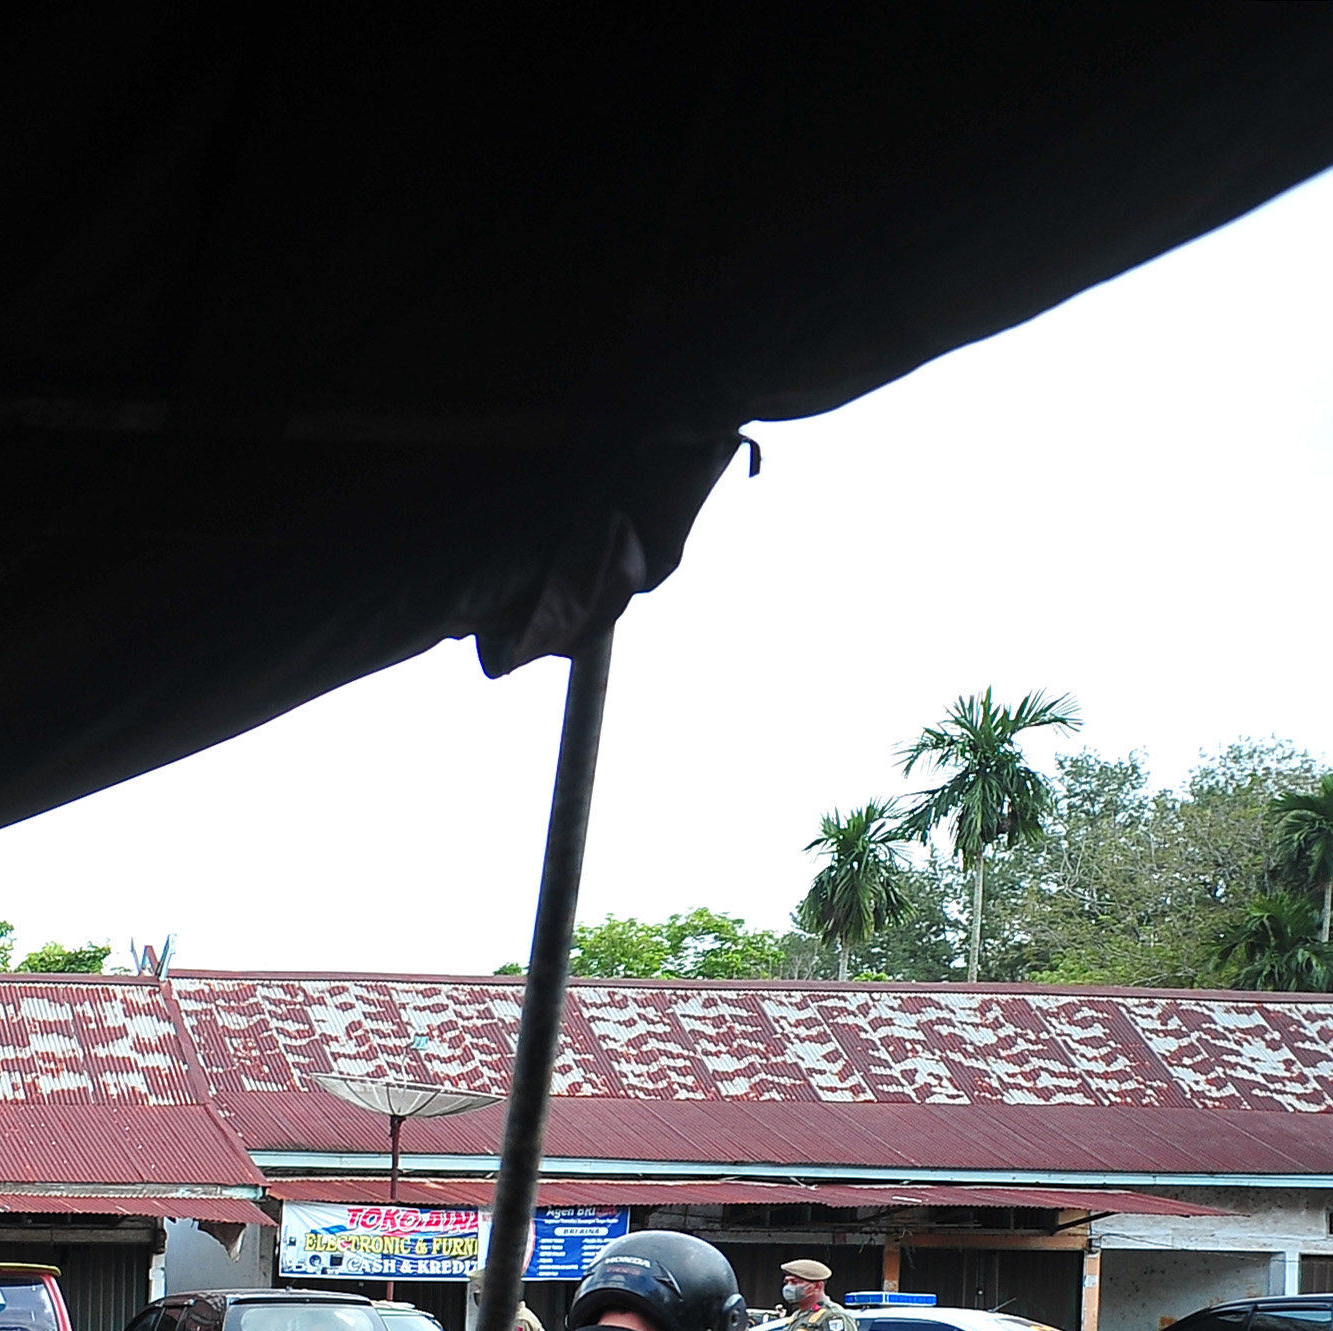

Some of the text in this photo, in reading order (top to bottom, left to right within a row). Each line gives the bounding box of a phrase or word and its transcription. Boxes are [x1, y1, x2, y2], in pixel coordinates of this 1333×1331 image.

[305, 1233, 412, 1255] ELECTRONIC
[415, 1237, 428, 1255] &
[346, 1256, 397, 1275] CASH
[399, 1258, 416, 1275] &
[604, 1255, 652, 1268] HONDA
